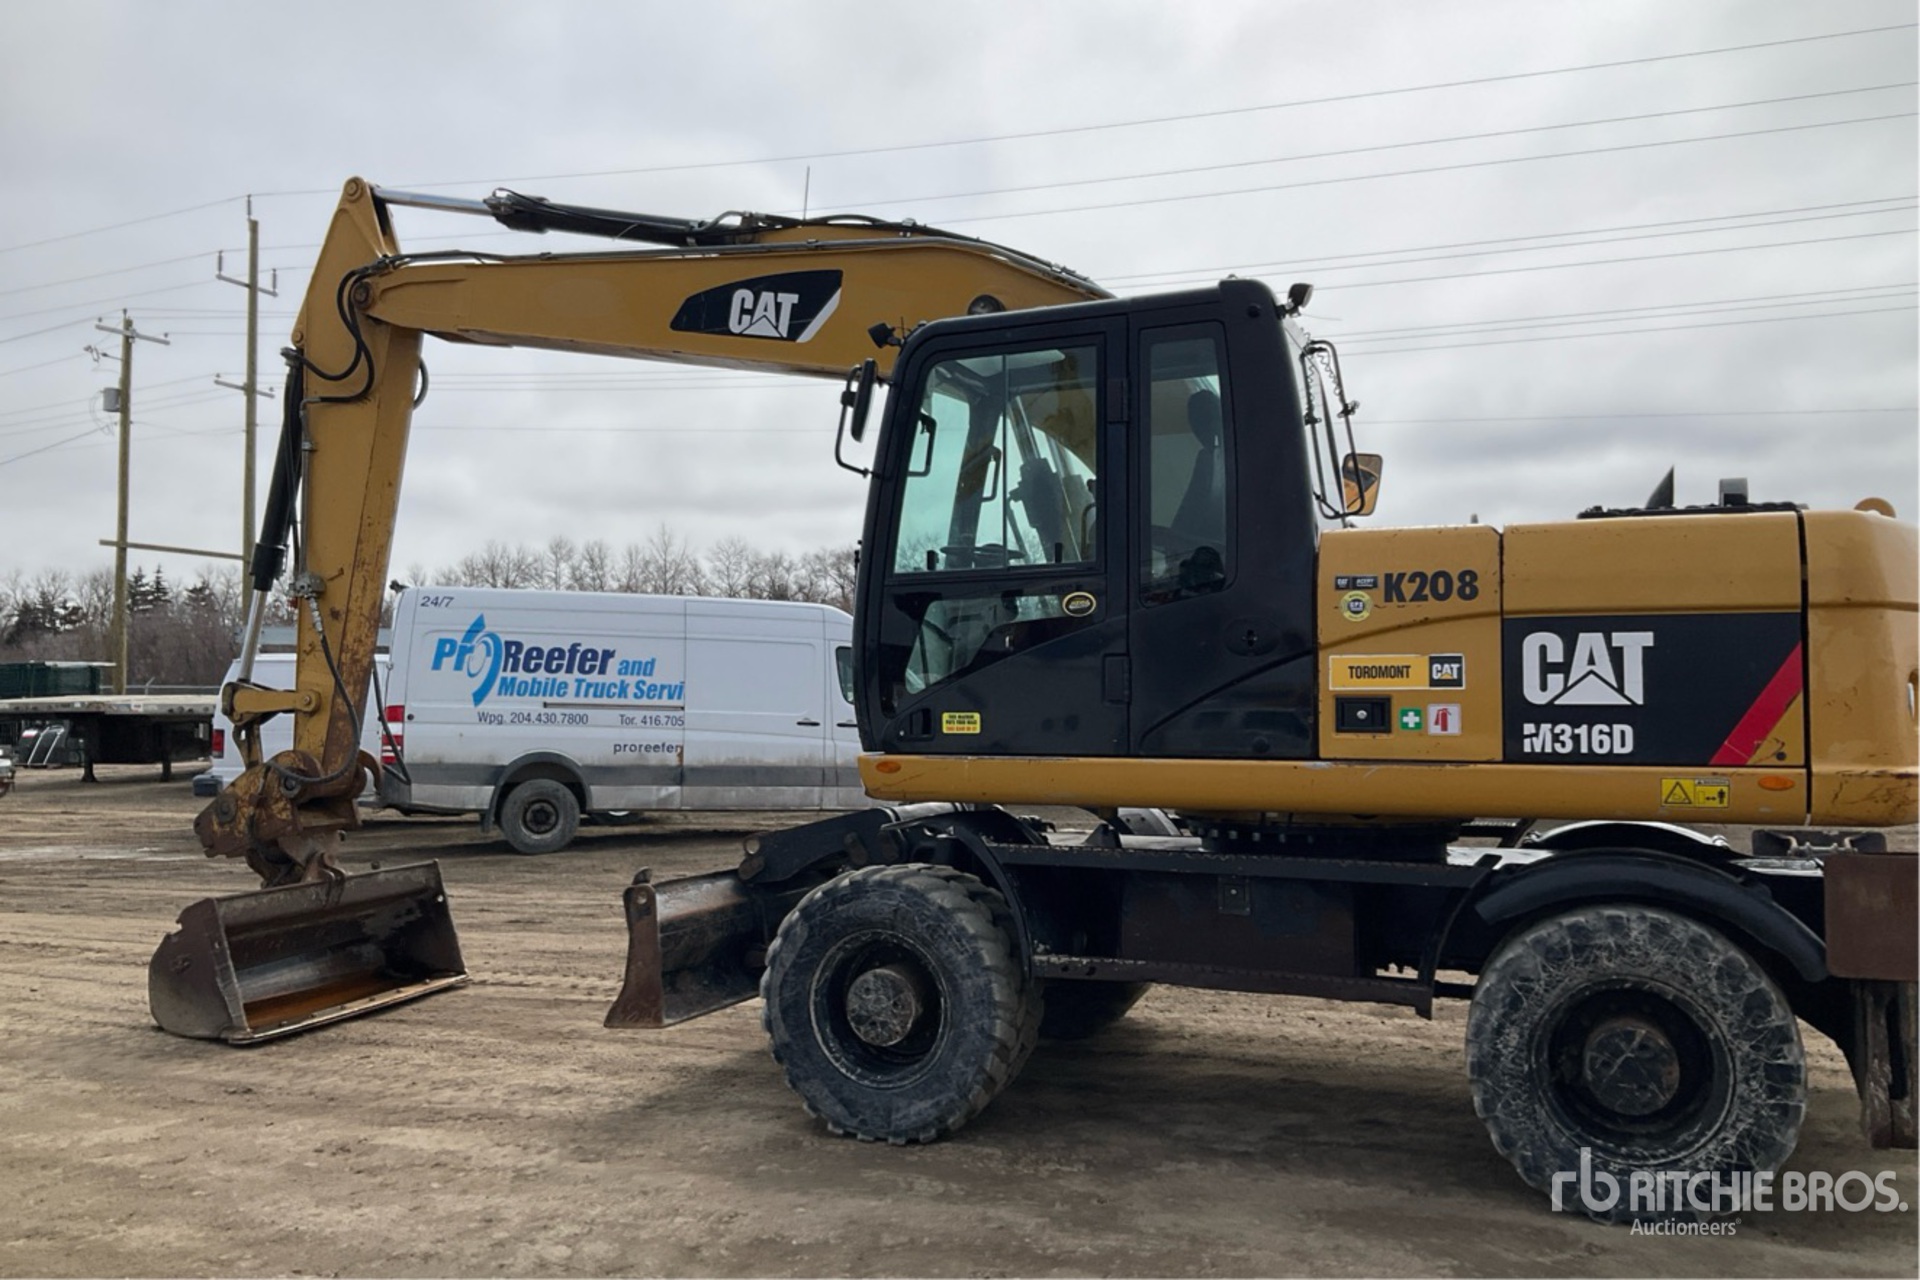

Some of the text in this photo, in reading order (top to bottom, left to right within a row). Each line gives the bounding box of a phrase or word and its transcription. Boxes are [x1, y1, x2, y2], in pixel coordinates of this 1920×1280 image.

[728, 288, 800, 338] CAT
[1383, 569, 1479, 603] K208
[420, 595, 454, 608] 24/7
[617, 657, 656, 677] and
[1348, 665, 1411, 679] TOROMONT
[1431, 663, 1461, 680] CAT
[1522, 631, 1654, 706] CAT
[497, 676, 568, 698] Mobile
[574, 677, 630, 699] Truck
[477, 711, 589, 725] Wpg. 204.430.7800
[619, 714, 685, 727] Tor. 416.705
[1523, 722, 1634, 755] M316D
